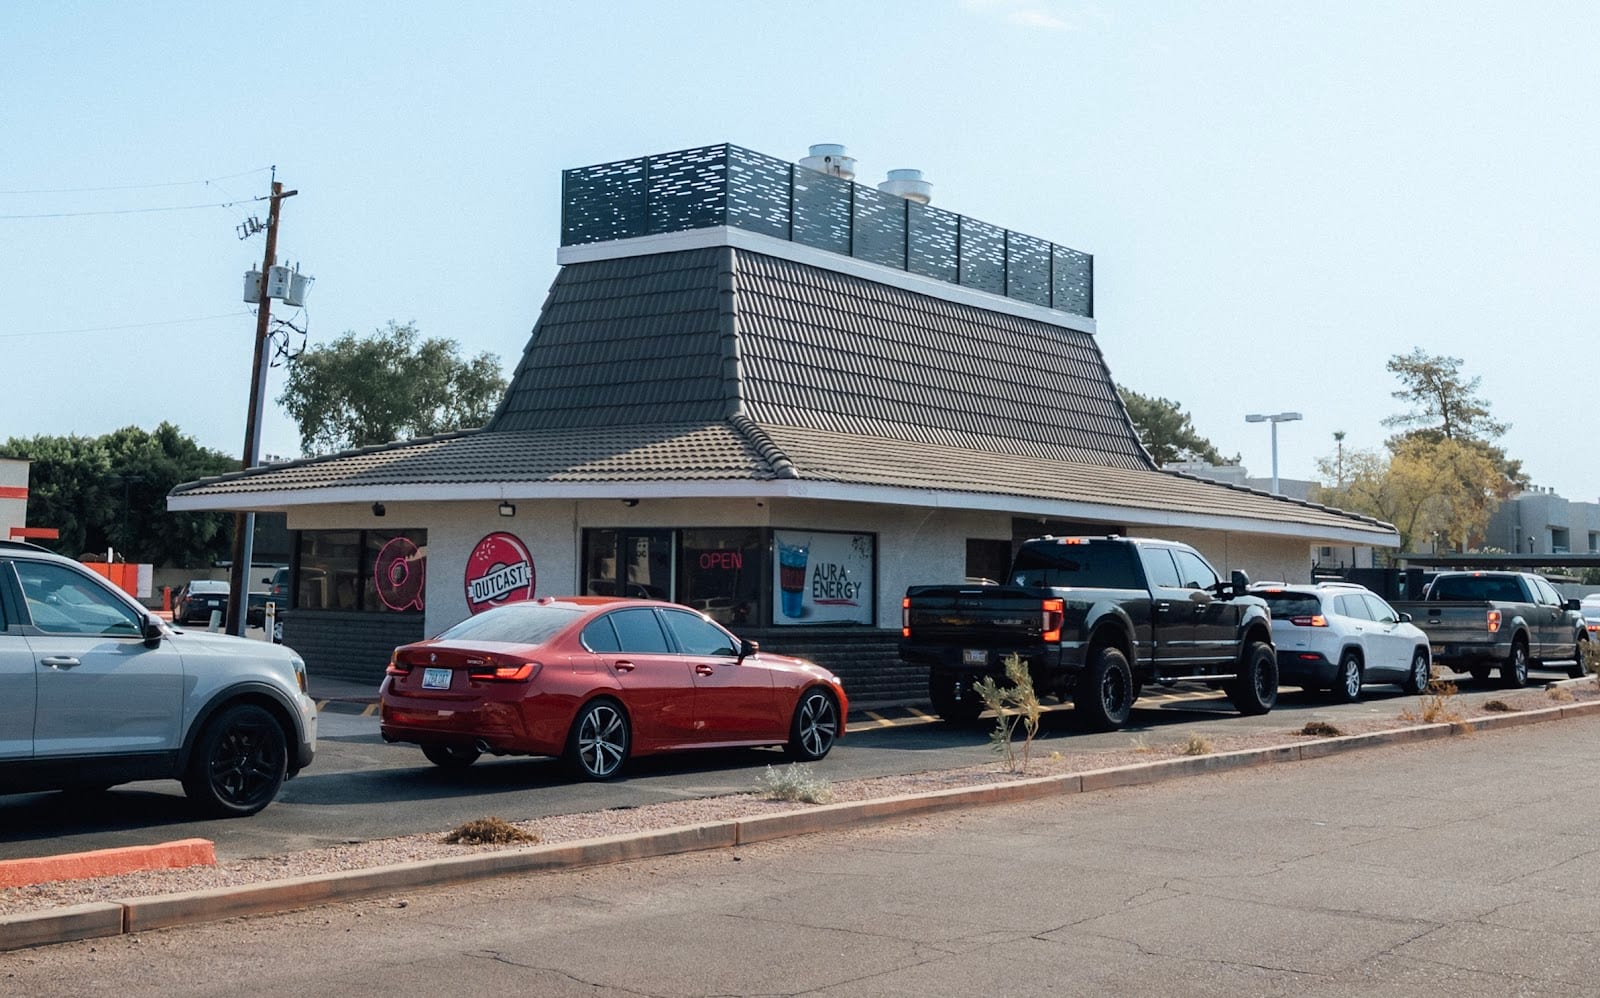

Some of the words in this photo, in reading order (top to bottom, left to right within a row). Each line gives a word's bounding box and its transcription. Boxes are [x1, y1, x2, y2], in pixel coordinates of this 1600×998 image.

[700, 552, 742, 569] OPEN
[813, 563, 847, 581] AURA
[475, 566, 522, 599] OUTCAST
[812, 581, 861, 599] ENERGY
